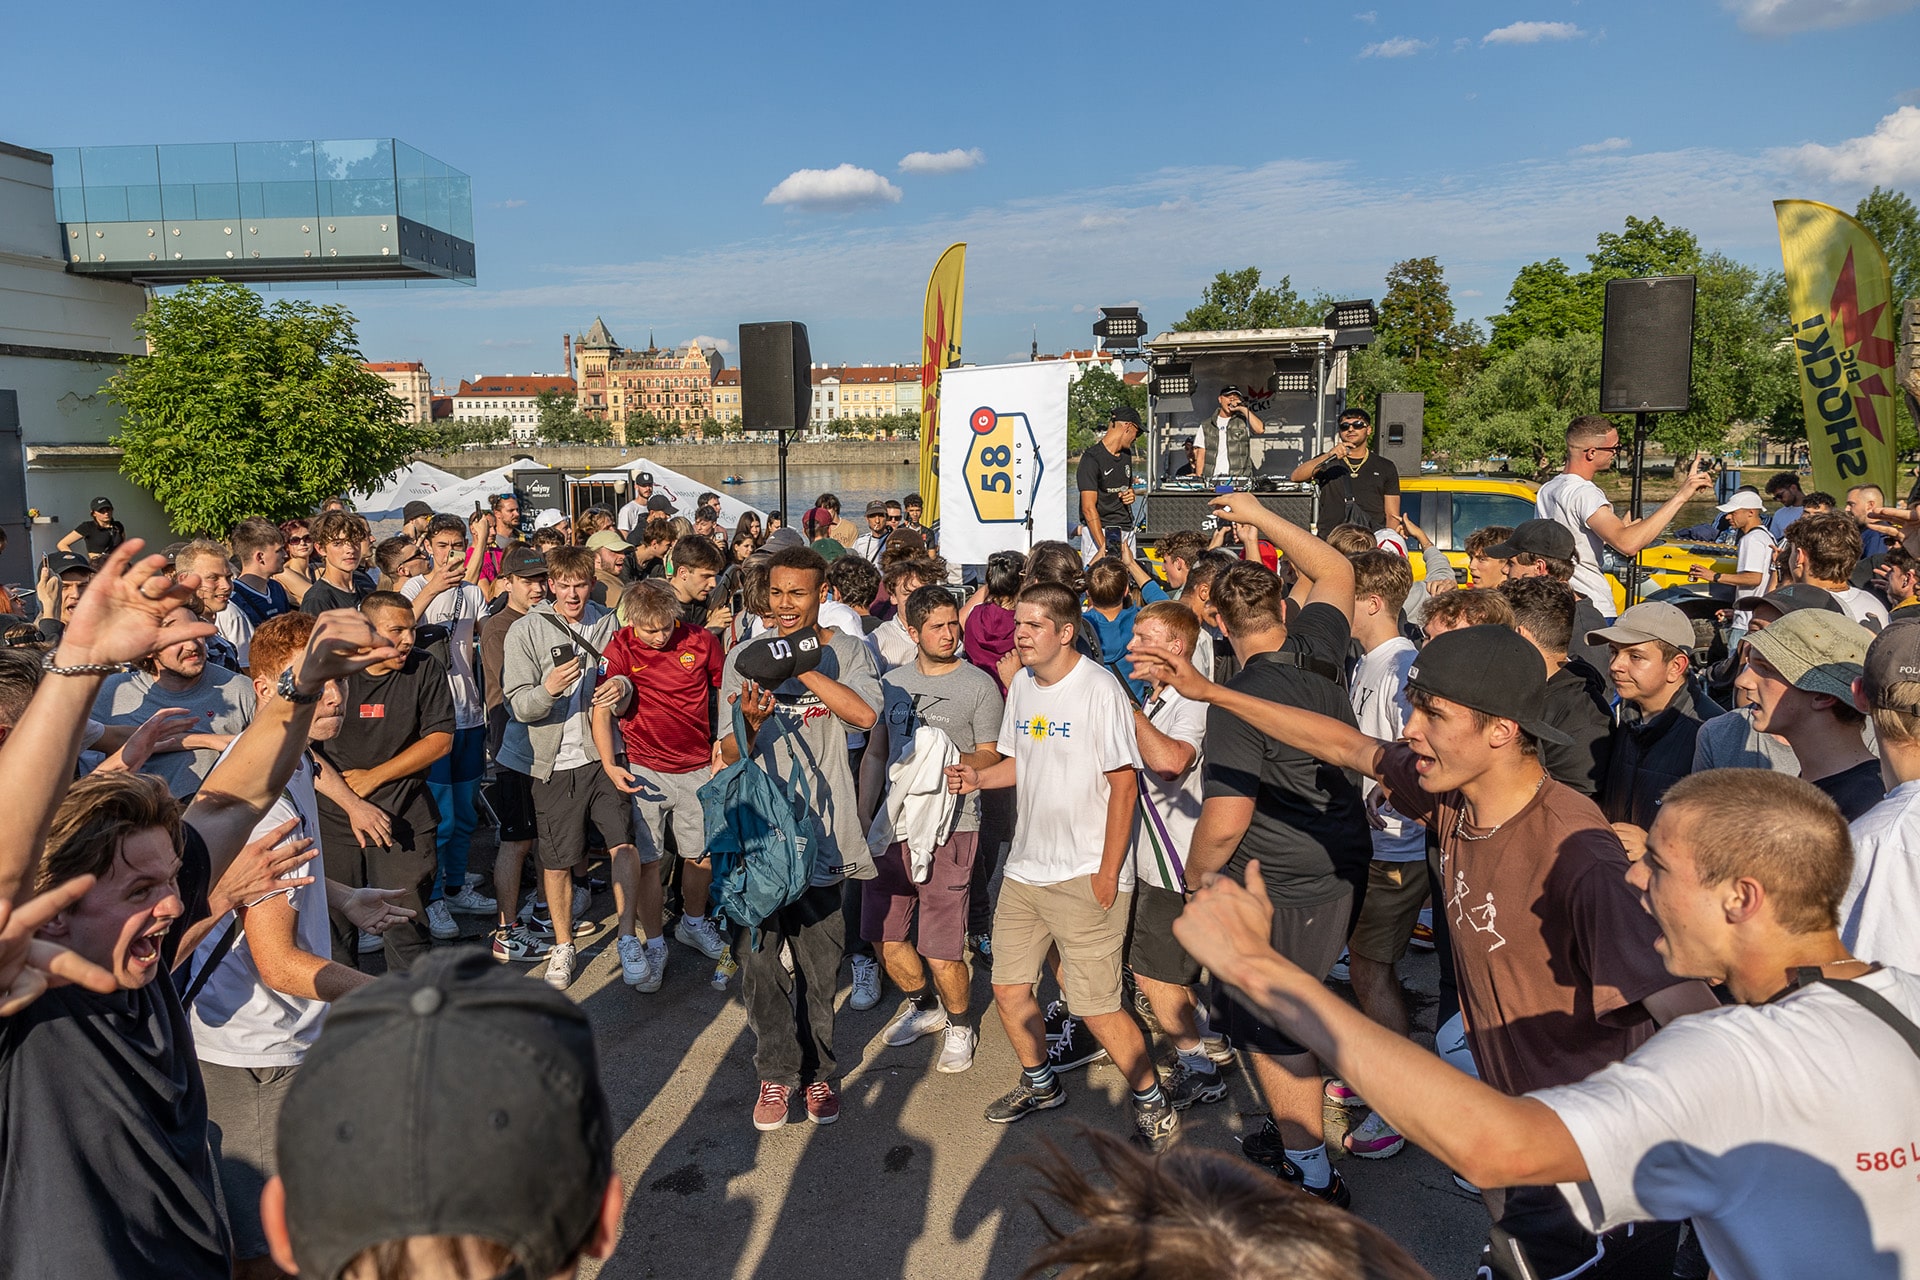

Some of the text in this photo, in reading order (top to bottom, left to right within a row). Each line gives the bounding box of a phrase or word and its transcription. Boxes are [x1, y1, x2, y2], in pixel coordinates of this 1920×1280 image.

[980, 444, 1012, 494] 58
[521, 522, 535, 532] BA
[1201, 519, 1218, 531] SH
[928, 712, 951, 723] Jeans
[1015, 719, 1071, 738] PEACE
[1856, 1142, 1920, 1172] 58G L
